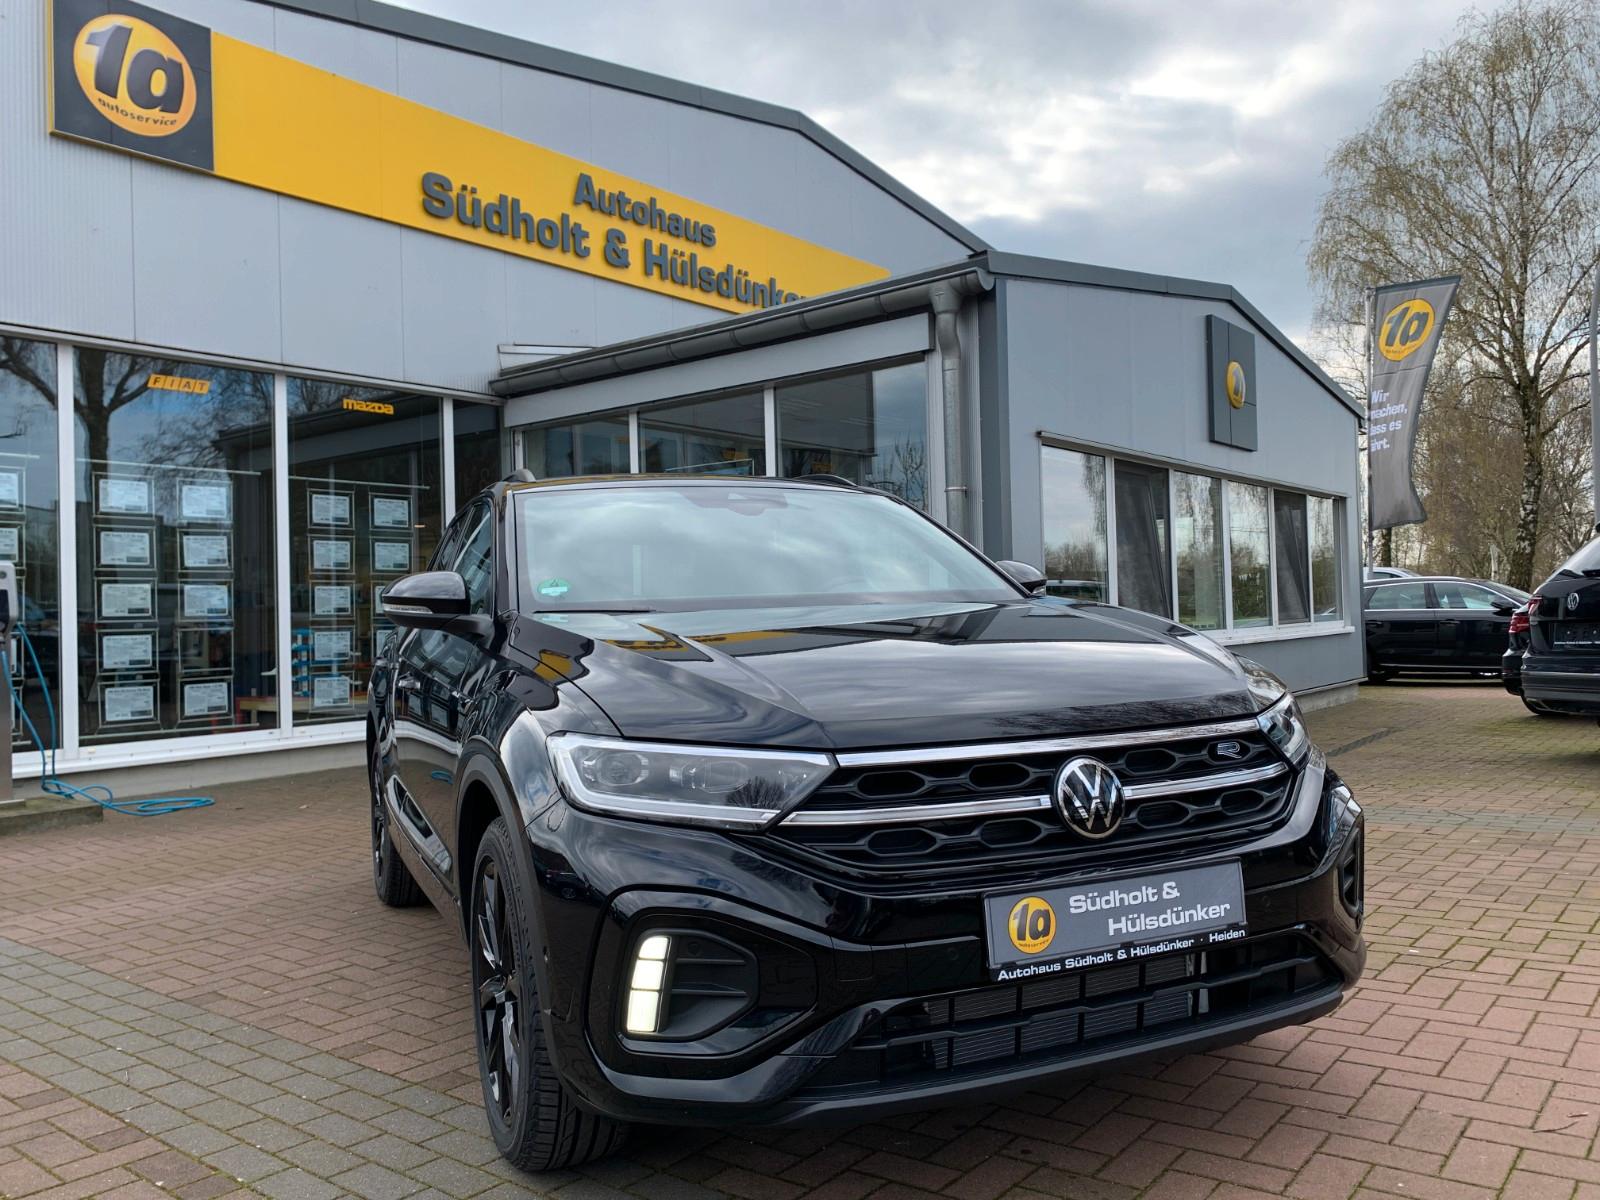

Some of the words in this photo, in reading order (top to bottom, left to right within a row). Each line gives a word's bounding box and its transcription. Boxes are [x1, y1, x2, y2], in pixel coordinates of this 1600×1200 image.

[85, 24, 185, 114] 1a
[98, 98, 177, 126] autoservice
[574, 172, 716, 247] Autohaus
[422, 172, 590, 257] Südholt
[604, 228, 630, 268] &
[644, 238, 806, 308] Hülsdünk
[1385, 307, 1429, 346] 1a
[153, 376, 206, 391] FIAT
[343, 398, 394, 415] mazda
[1389, 420, 1402, 430] es
[1069, 885, 1158, 914] Südholt
[1162, 881, 1180, 899] &
[1013, 903, 1051, 941] 1a
[1108, 903, 1230, 936] Hülsdünker
[998, 963, 1061, 981] Autohaus
[1065, 952, 1113, 969] Südholt
[1117, 949, 1127, 960] &
[1130, 939, 1194, 957] Hülsdünker
[1209, 929, 1245, 943] Heiden
